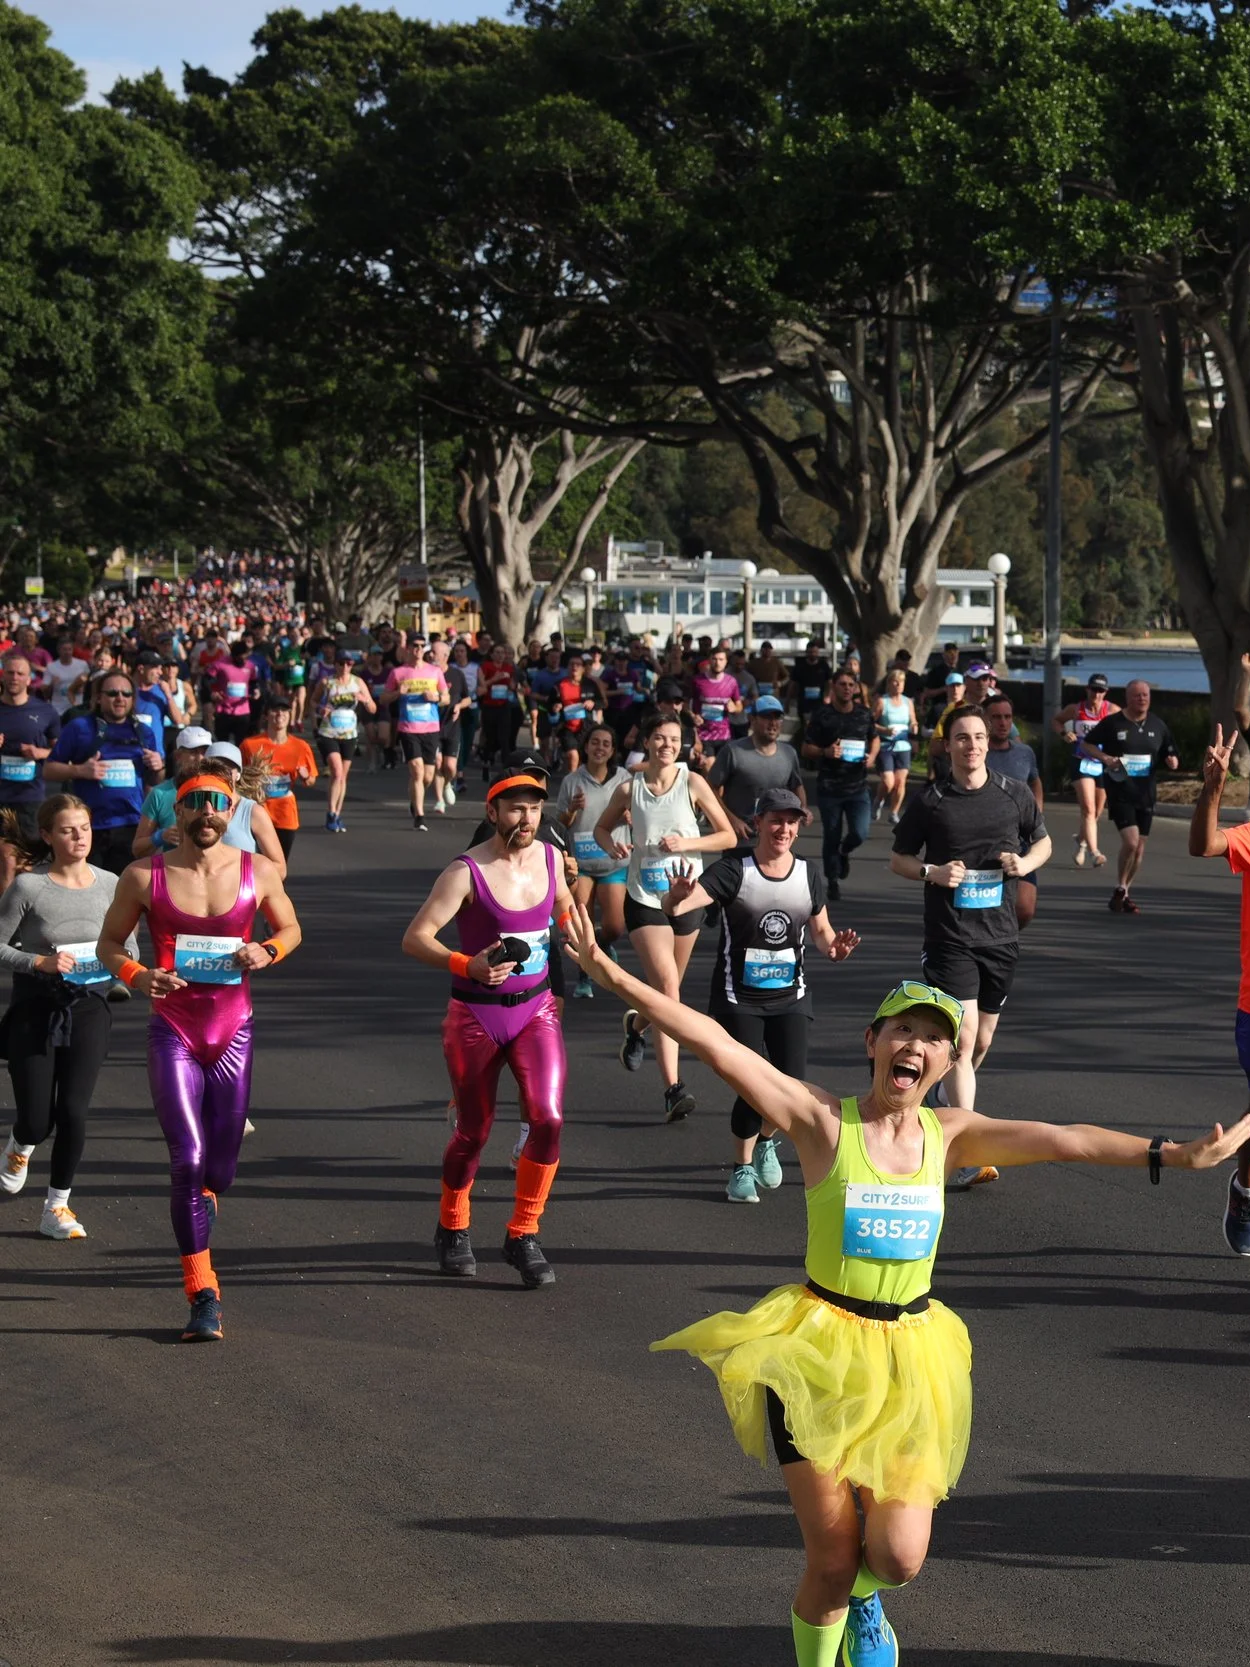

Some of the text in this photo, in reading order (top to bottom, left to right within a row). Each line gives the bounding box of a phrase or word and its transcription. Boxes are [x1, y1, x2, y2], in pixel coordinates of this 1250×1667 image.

[961, 887, 998, 899] 36106
[184, 957, 233, 972] 41578
[751, 966, 790, 978] 36105
[861, 1192, 930, 1206] CITY2SURF
[856, 1217, 931, 1240] 38522
